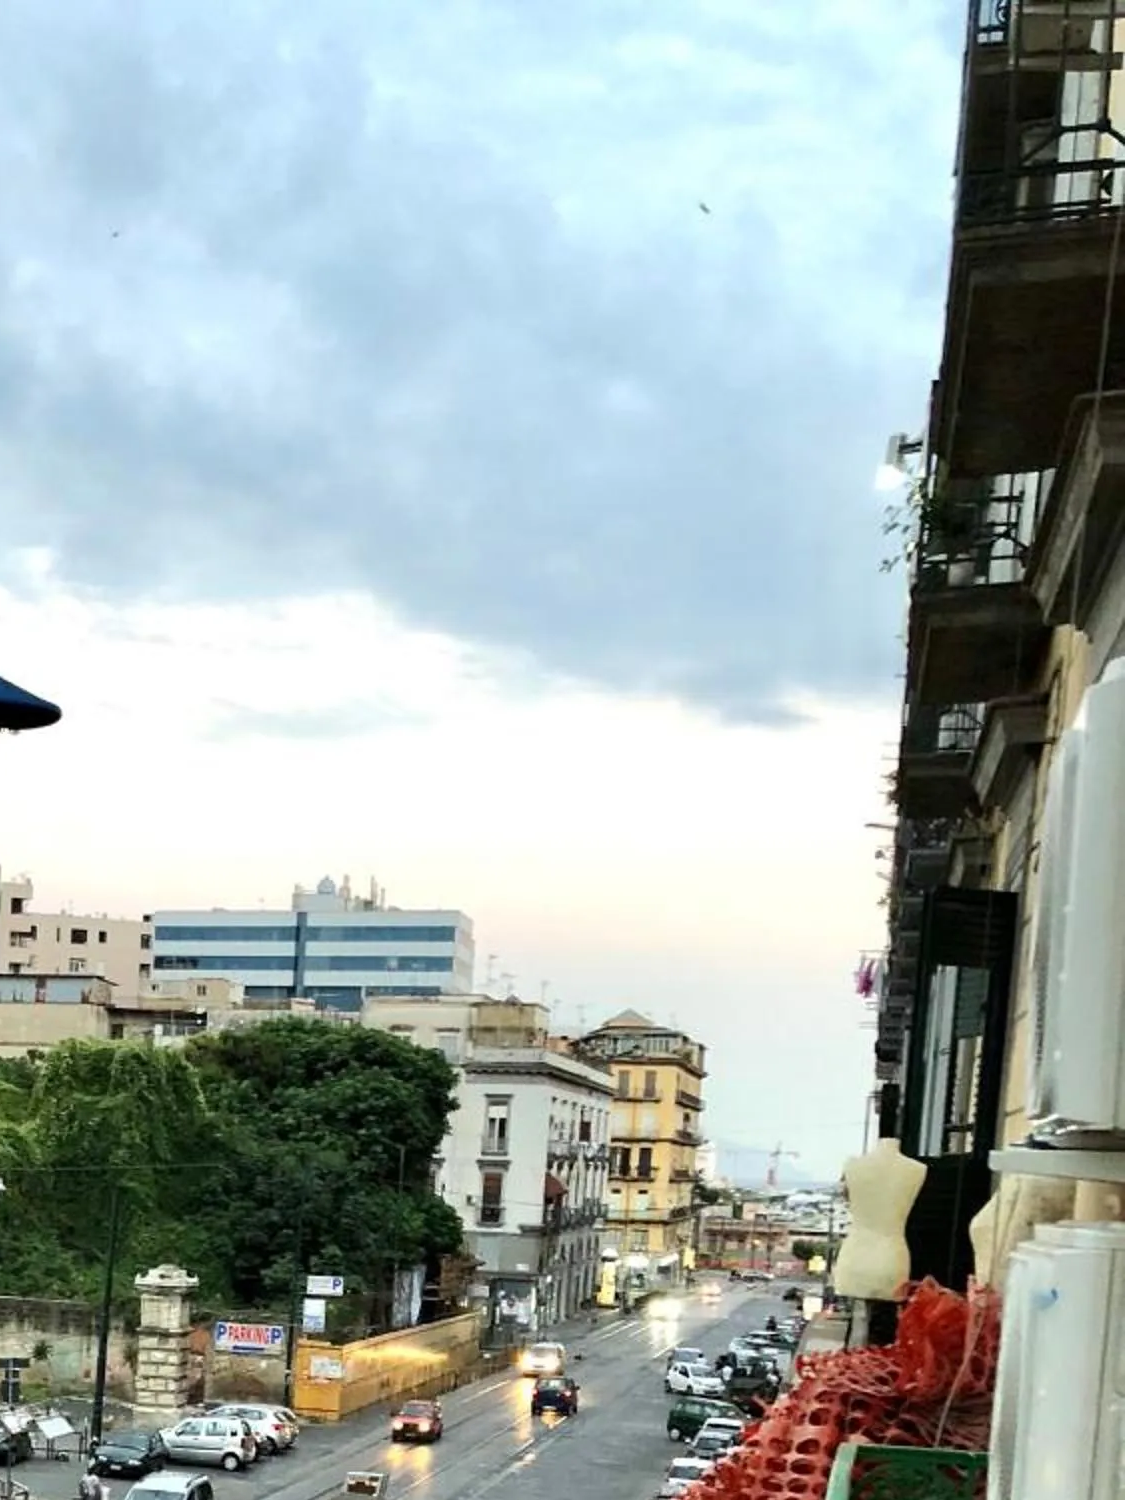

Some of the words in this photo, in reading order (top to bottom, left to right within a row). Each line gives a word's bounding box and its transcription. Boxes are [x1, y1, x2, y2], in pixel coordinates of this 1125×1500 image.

[332, 1279, 342, 1290] P
[217, 1323, 227, 1341] P
[229, 1325, 270, 1345] PARKING
[271, 1327, 282, 1345] P
